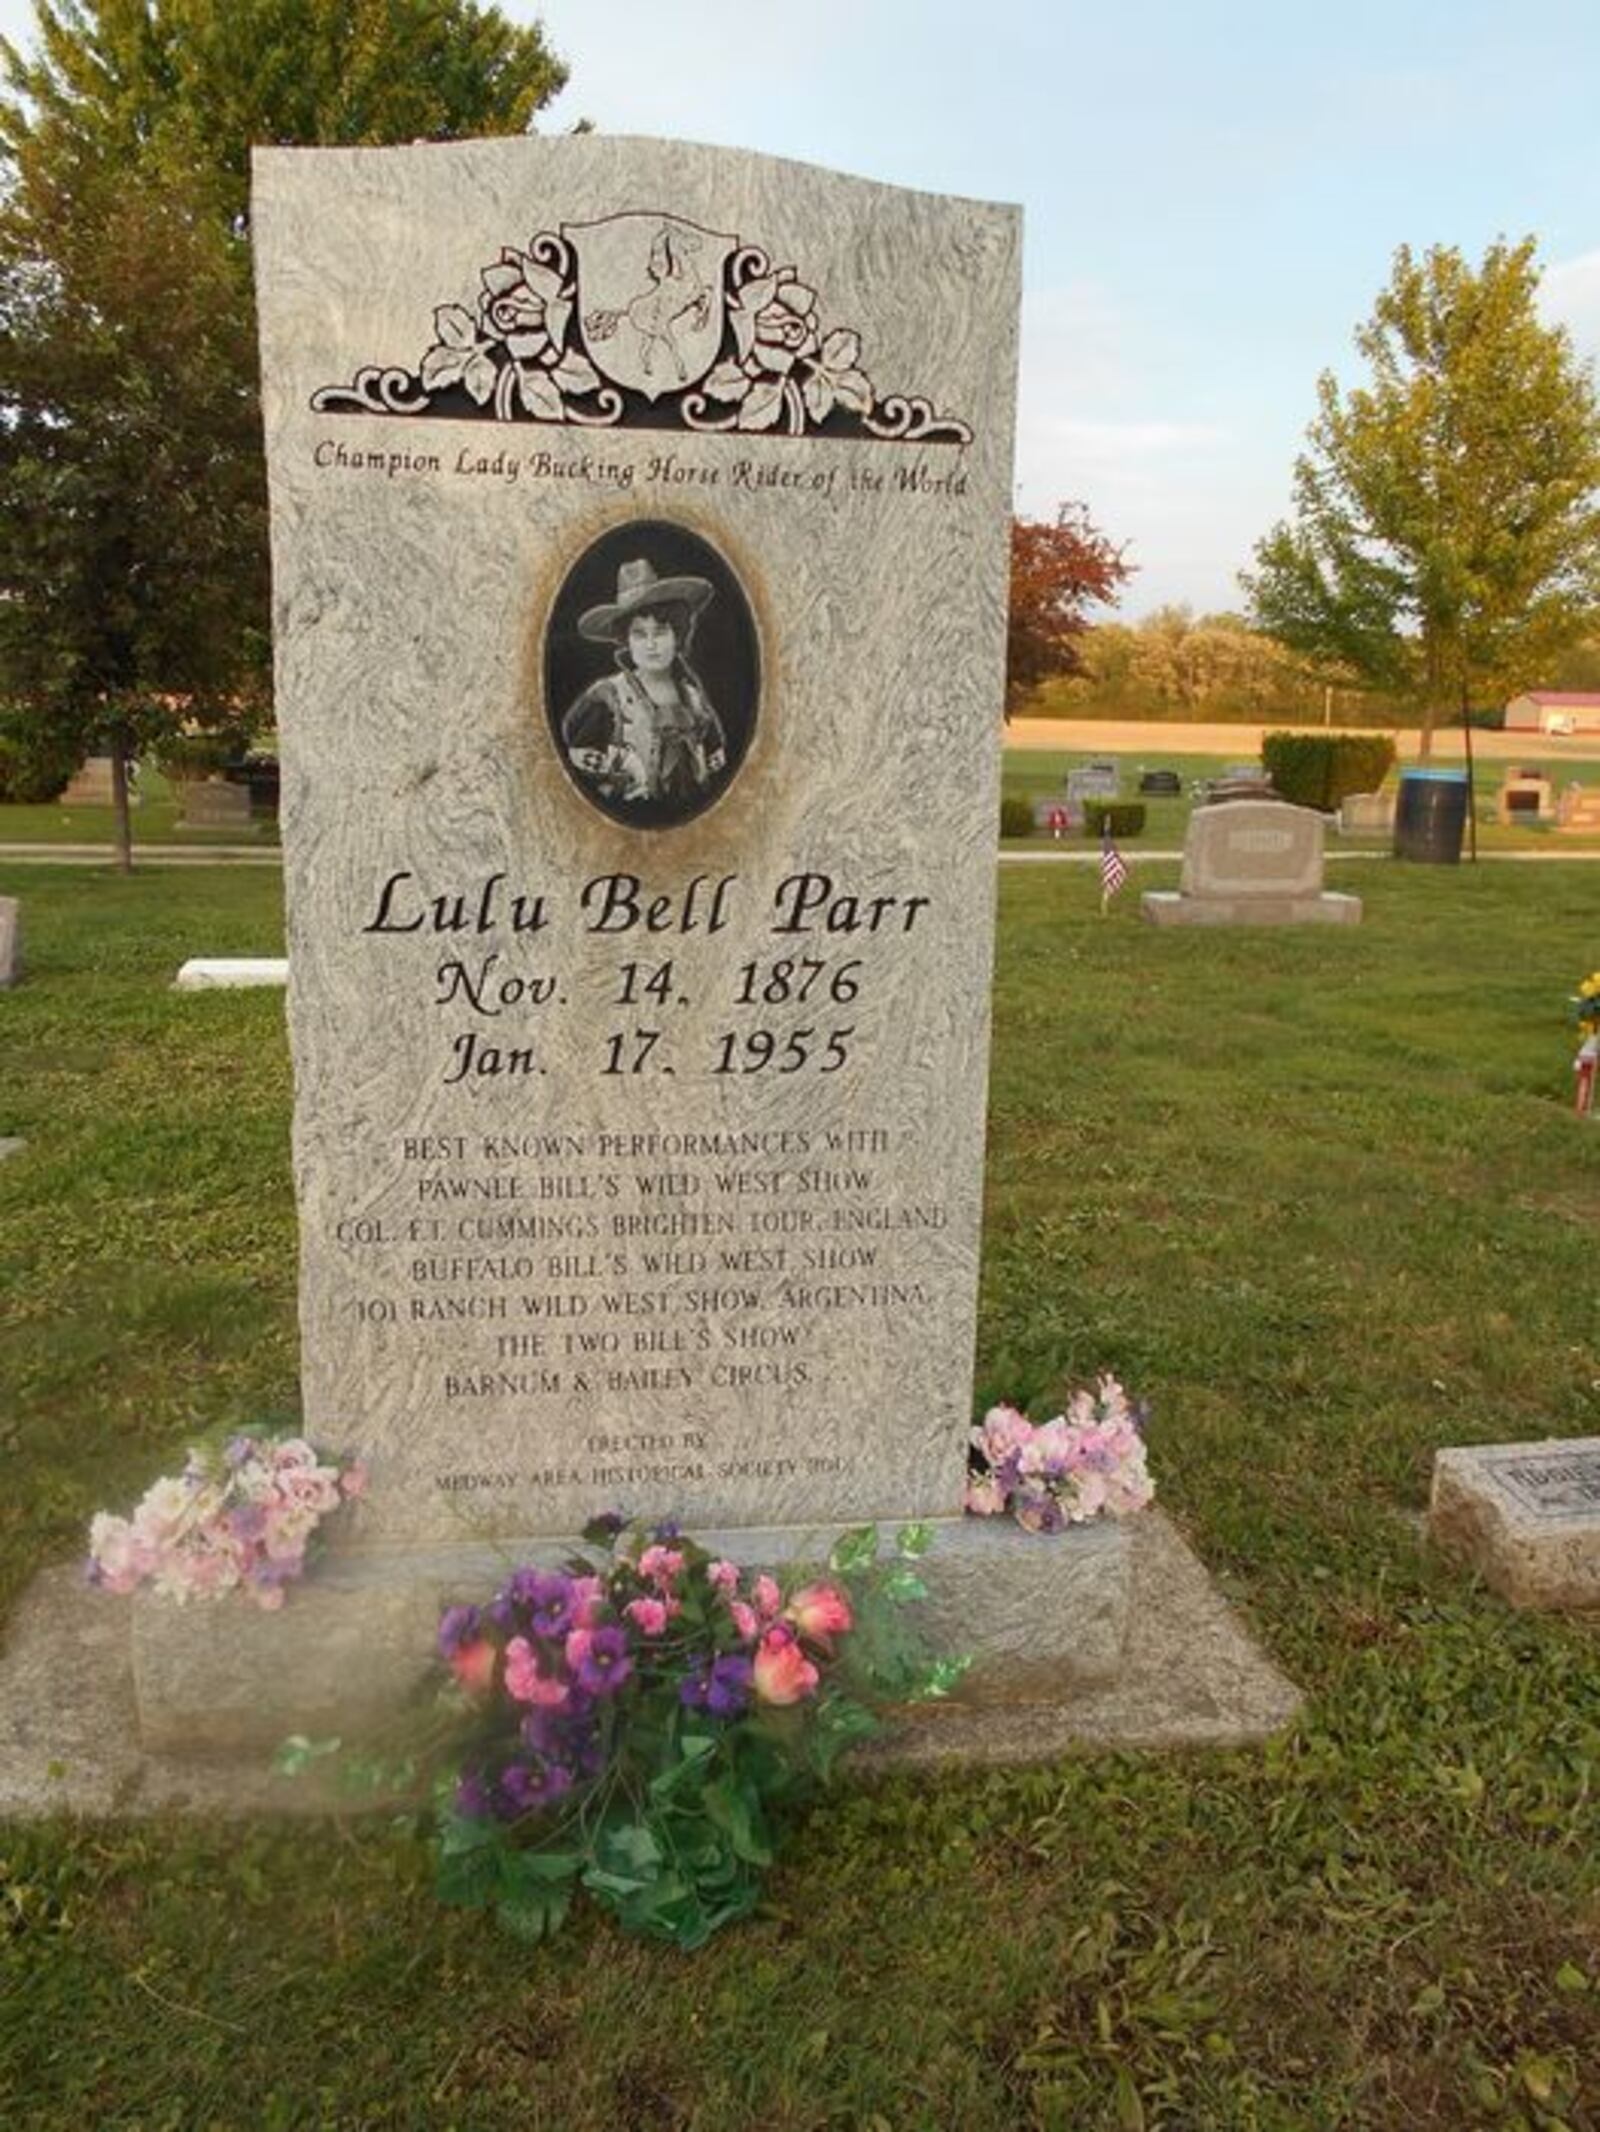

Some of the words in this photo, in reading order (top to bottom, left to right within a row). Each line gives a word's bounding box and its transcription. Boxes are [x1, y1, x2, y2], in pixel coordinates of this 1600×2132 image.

[313, 440, 441, 478] Champion
[455, 448, 521, 484] Lady
[529, 451, 635, 489] Bucking
[645, 453, 721, 487] Horse
[730, 459, 802, 493] Rider
[811, 463, 840, 497] of
[850, 465, 883, 494] the
[892, 458, 967, 497] World
[362, 871, 550, 934] Lulu
[579, 872, 739, 935] Bell
[770, 873, 932, 935] Parr
[434, 954, 569, 1016] Nov.
[732, 959, 863, 1005] 1876
[443, 1032, 548, 1083] Jan.
[711, 1025, 856, 1075] 1955
[402, 1136, 468, 1160] BEST
[483, 1134, 585, 1158] KNOWN
[600, 1131, 811, 1156] PERFORMANCES
[825, 1129, 889, 1153] WITH
[418, 1176, 526, 1201] PAWNEE
[540, 1173, 620, 1199] BILL'S
[636, 1173, 700, 1197] WILD
[714, 1170, 782, 1195] WEST
[799, 1169, 874, 1193] SHOW
[458, 1215, 600, 1240] CUMMINGS
[613, 1211, 735, 1236] BRIGHTEN
[832, 1205, 949, 1230] ENGLAND
[411, 1256, 534, 1282] BUFFALO
[549, 1252, 629, 1279] BILL'S
[642, 1251, 707, 1275] WILD
[719, 1249, 787, 1273] WEST
[802, 1247, 878, 1270] SHOW
[409, 1297, 507, 1321] RANCH
[522, 1295, 588, 1319] WILD
[601, 1292, 670, 1317] WEST
[779, 1284, 926, 1309] ARGENTINA
[497, 1334, 547, 1357] THE
[563, 1331, 620, 1355] TWO
[633, 1328, 711, 1352] BILL'S
[722, 1325, 799, 1349] SHOW
[444, 1370, 561, 1398] BARNUM
[572, 1370, 590, 1393] &
[607, 1367, 693, 1391] BAILEY
[683, 1432, 707, 1450] BY
[434, 1472, 519, 1492] MEDWAY
[531, 1467, 582, 1487] AREA
